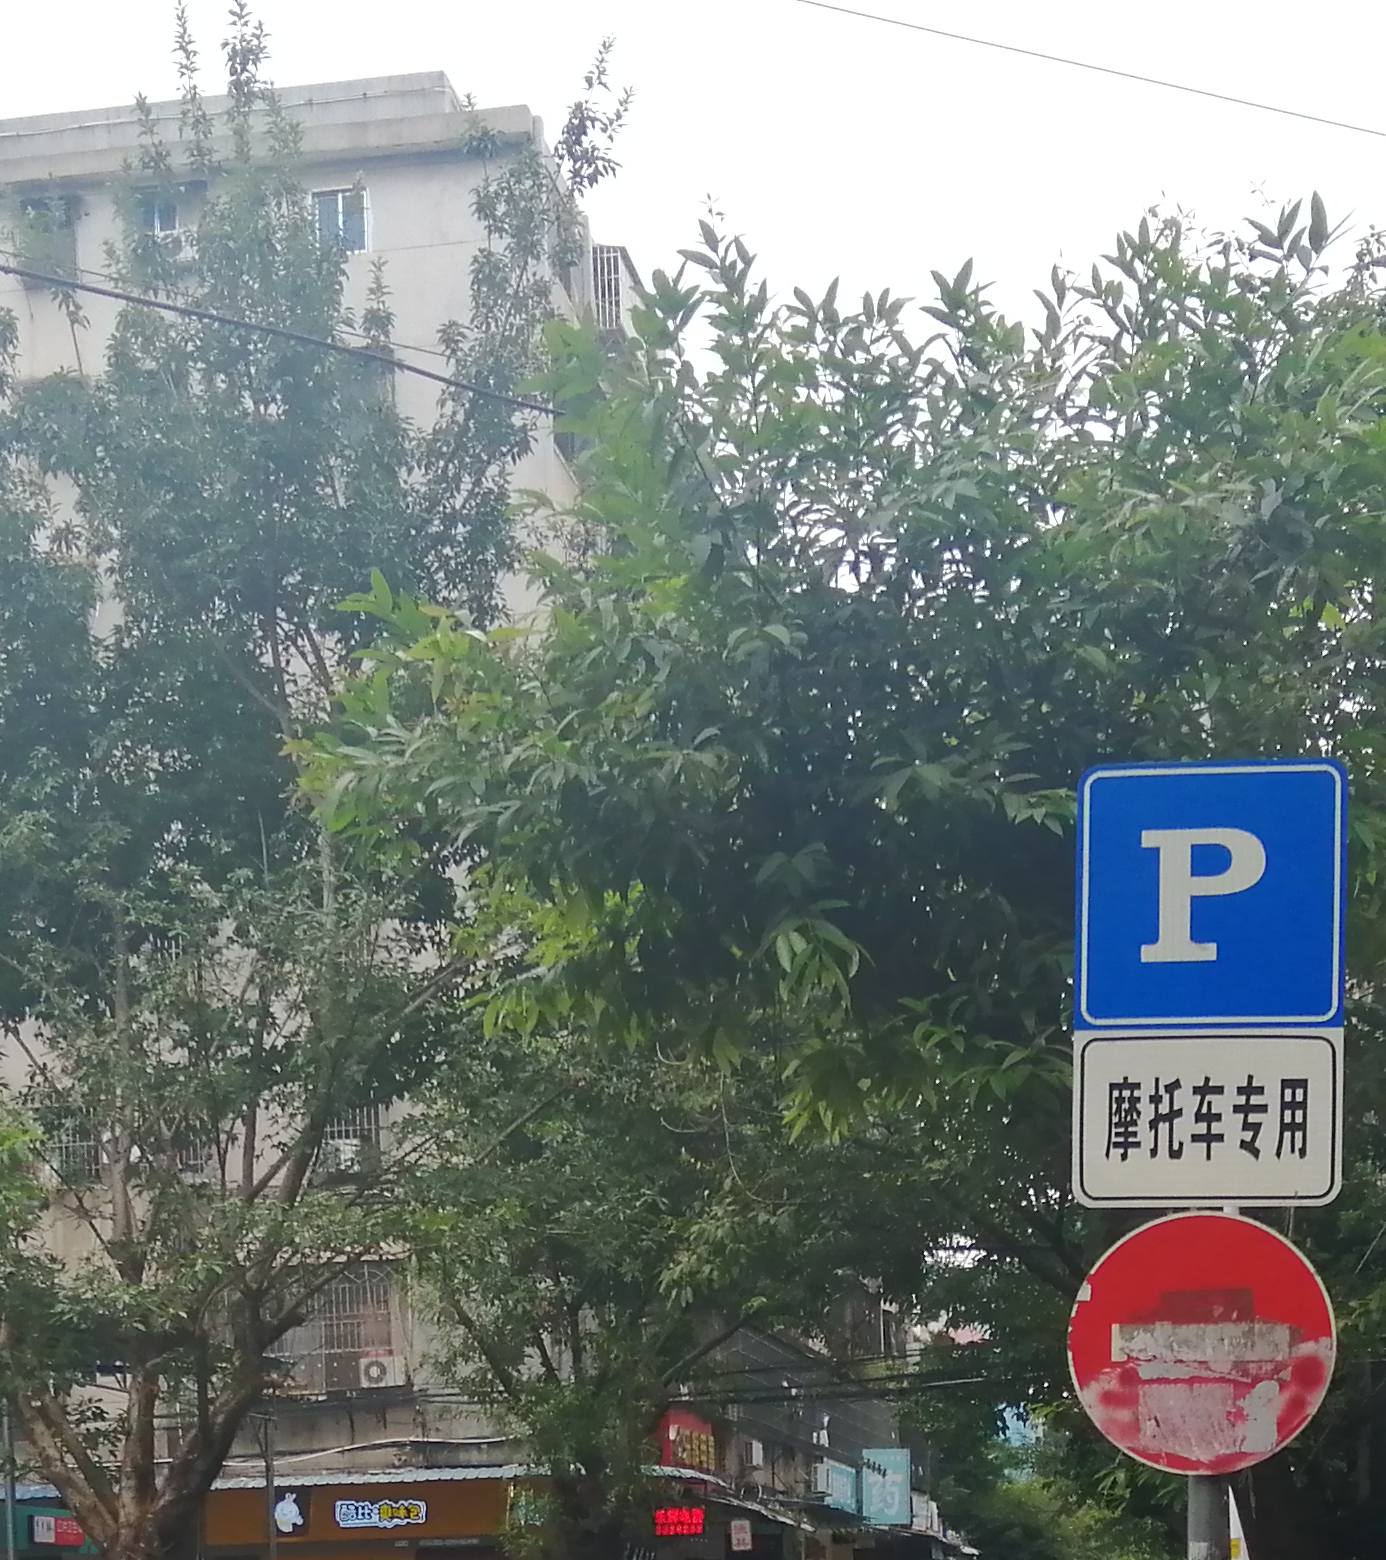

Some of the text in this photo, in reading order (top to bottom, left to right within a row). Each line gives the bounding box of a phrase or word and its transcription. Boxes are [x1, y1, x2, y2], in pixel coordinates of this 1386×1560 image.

[1140, 827, 1267, 963] P
[1104, 1075, 1309, 1162] 摩托车专用
